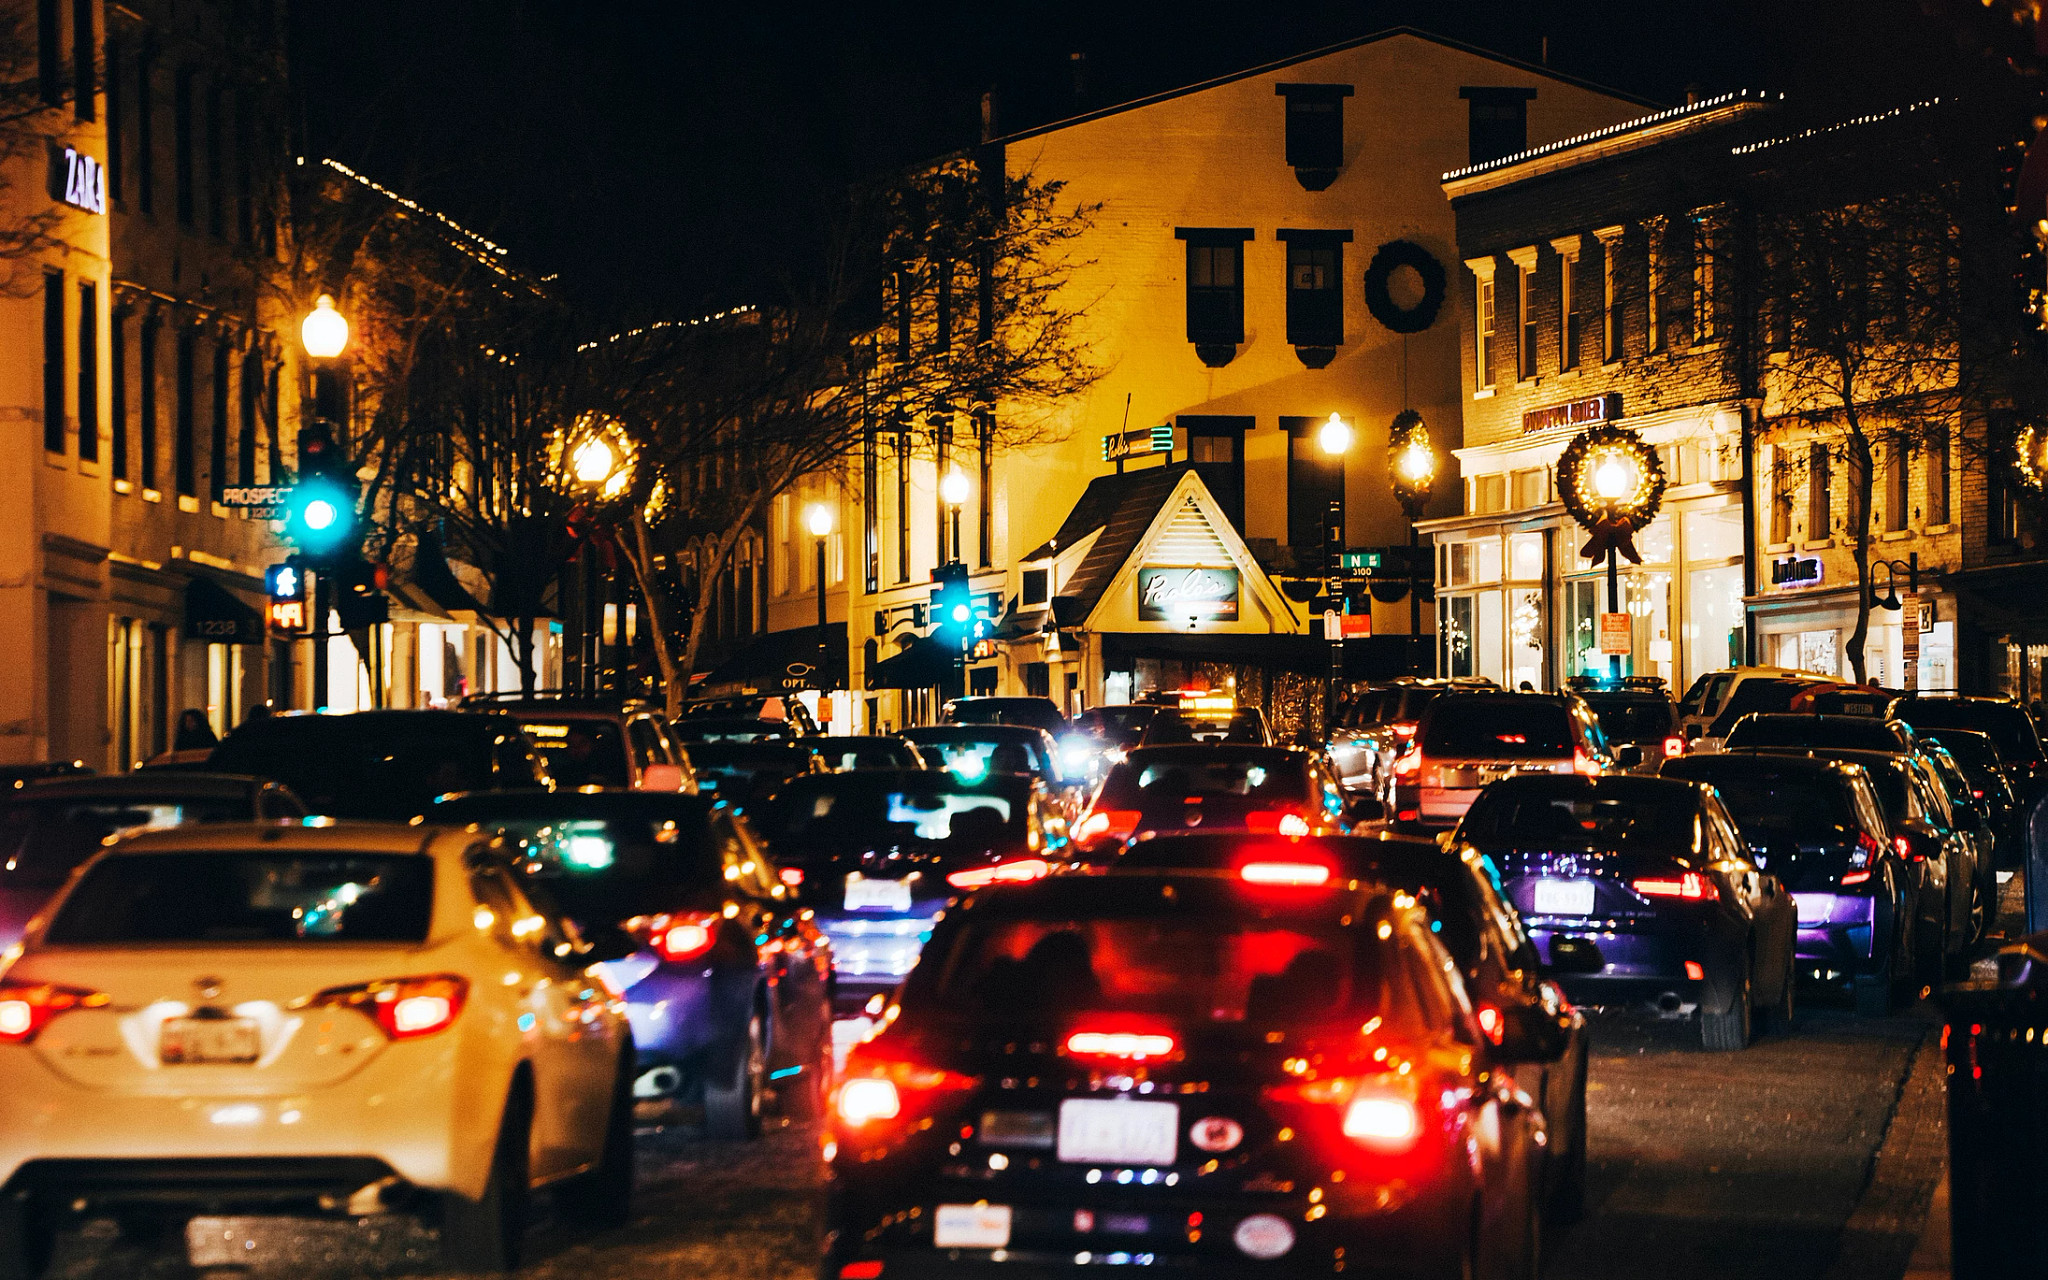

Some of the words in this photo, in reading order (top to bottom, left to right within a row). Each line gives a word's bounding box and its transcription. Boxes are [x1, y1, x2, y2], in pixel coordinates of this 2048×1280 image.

[65, 148, 106, 215] ZARA
[1351, 554, 1361, 567] N
[1353, 567, 1372, 576] 3100
